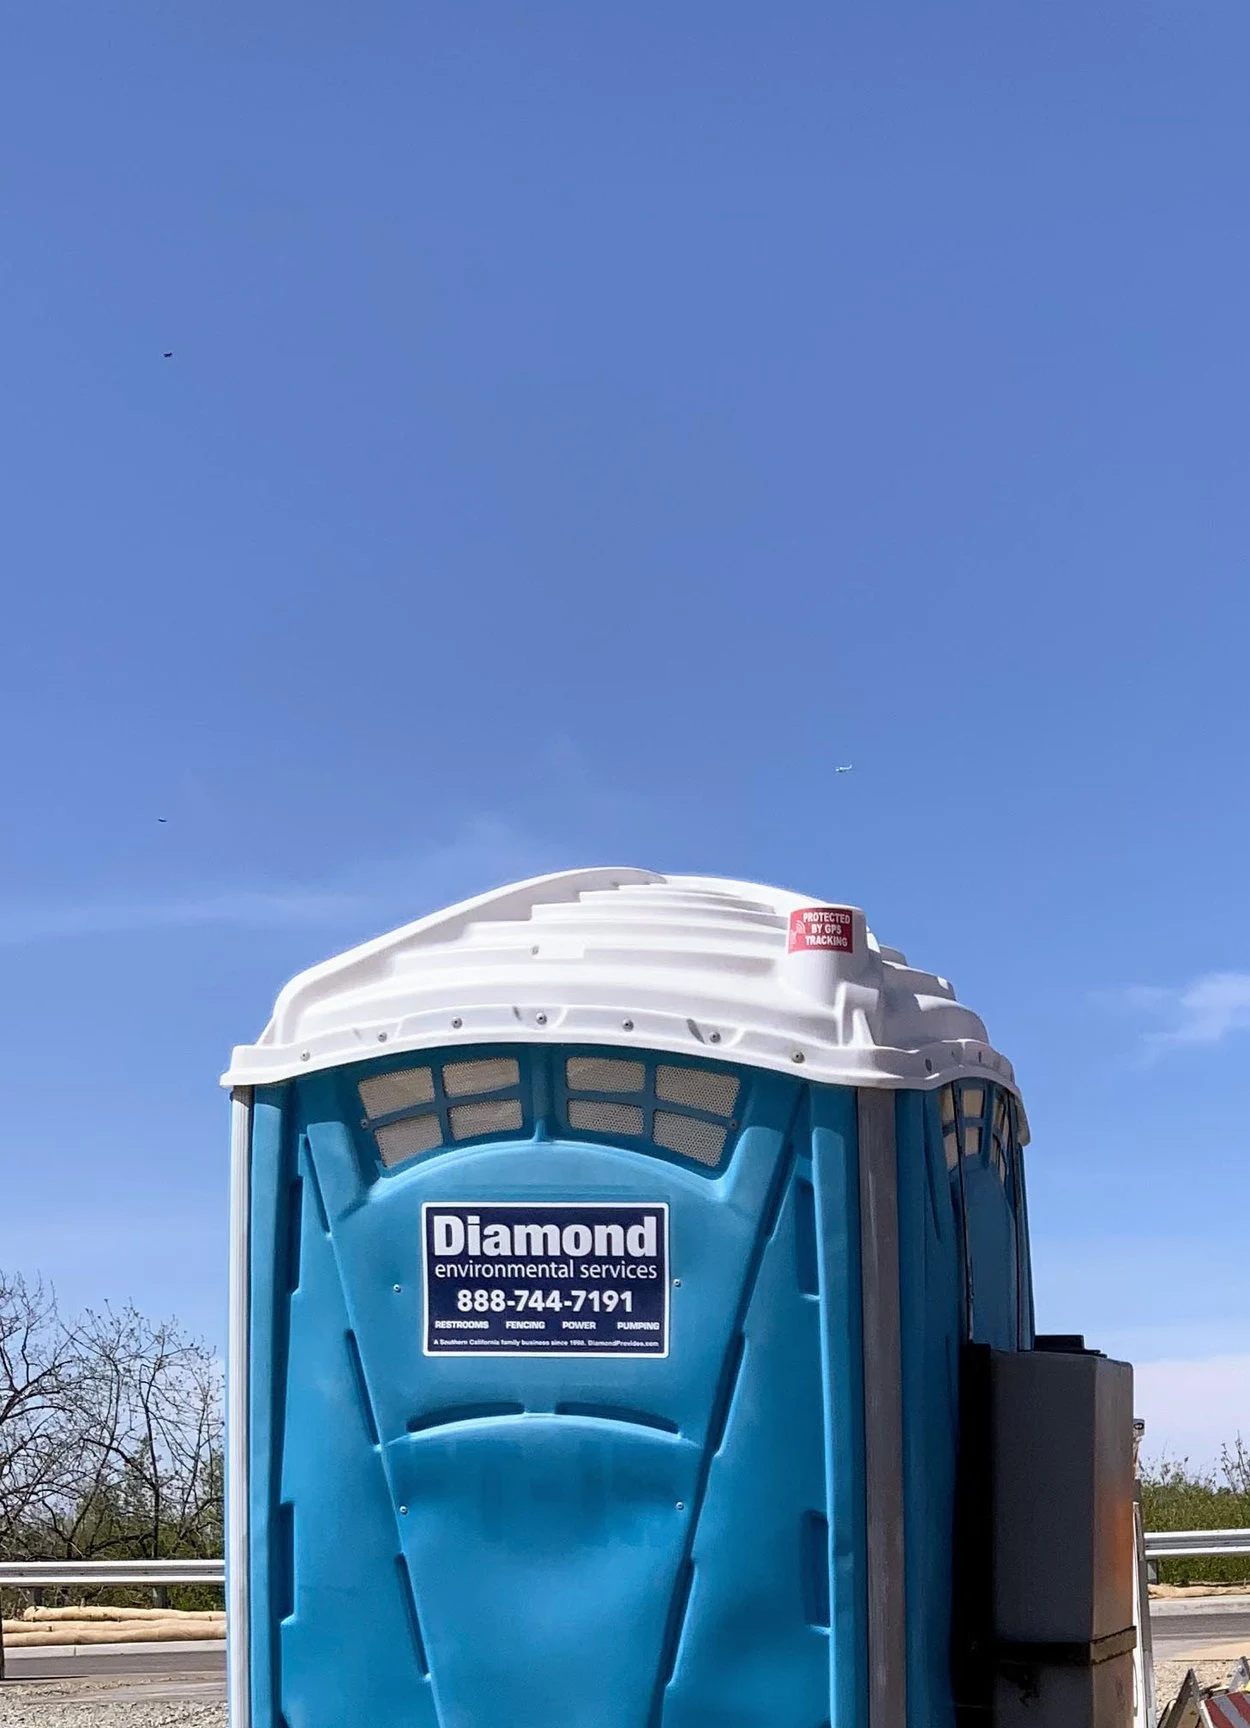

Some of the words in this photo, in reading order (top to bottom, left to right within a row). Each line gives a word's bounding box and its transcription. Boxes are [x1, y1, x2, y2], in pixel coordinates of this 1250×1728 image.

[802, 911, 851, 924] PROTECTED
[811, 924, 823, 934] BY
[824, 924, 842, 934] GPS
[804, 934, 848, 947] TRACKING
[433, 1215, 657, 1257] Diamond
[434, 1259, 574, 1279] environmental
[580, 1260, 658, 1280] services
[457, 1289, 633, 1313] 888-744-7191
[434, 1320, 490, 1330] RESTROOMS
[505, 1320, 546, 1330] FENCING
[562, 1321, 597, 1330] POWER
[617, 1321, 660, 1331] PUMPING
